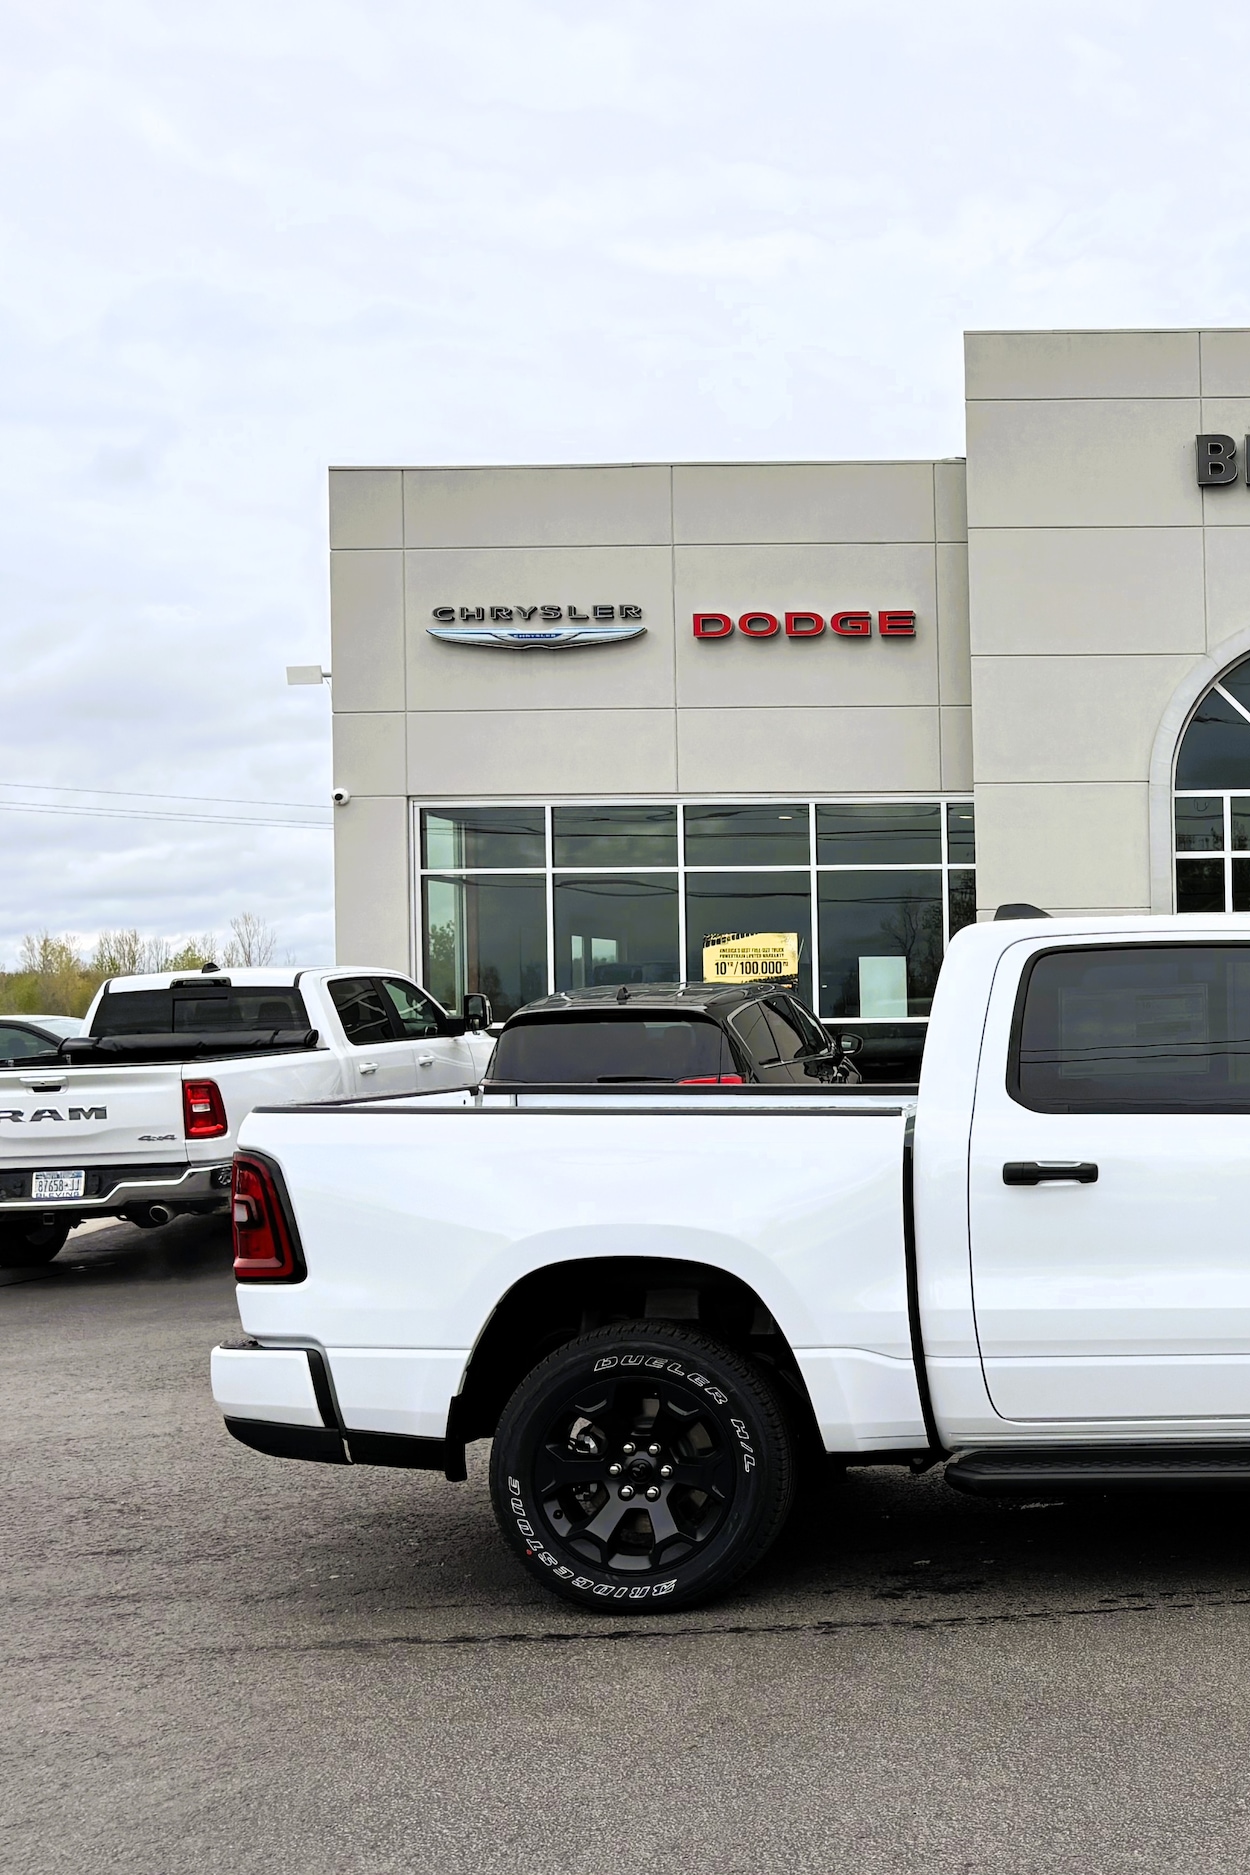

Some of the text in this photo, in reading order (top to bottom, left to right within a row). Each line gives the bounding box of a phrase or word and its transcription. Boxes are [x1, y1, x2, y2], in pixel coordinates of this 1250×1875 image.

[432, 604, 643, 622] CHRYSLER
[692, 610, 917, 640] DODGE
[0, 1105, 107, 1123] RAM
[594, 1355, 756, 1473] DUELER H/L
[507, 1475, 678, 1599] BRIDGESTONE
